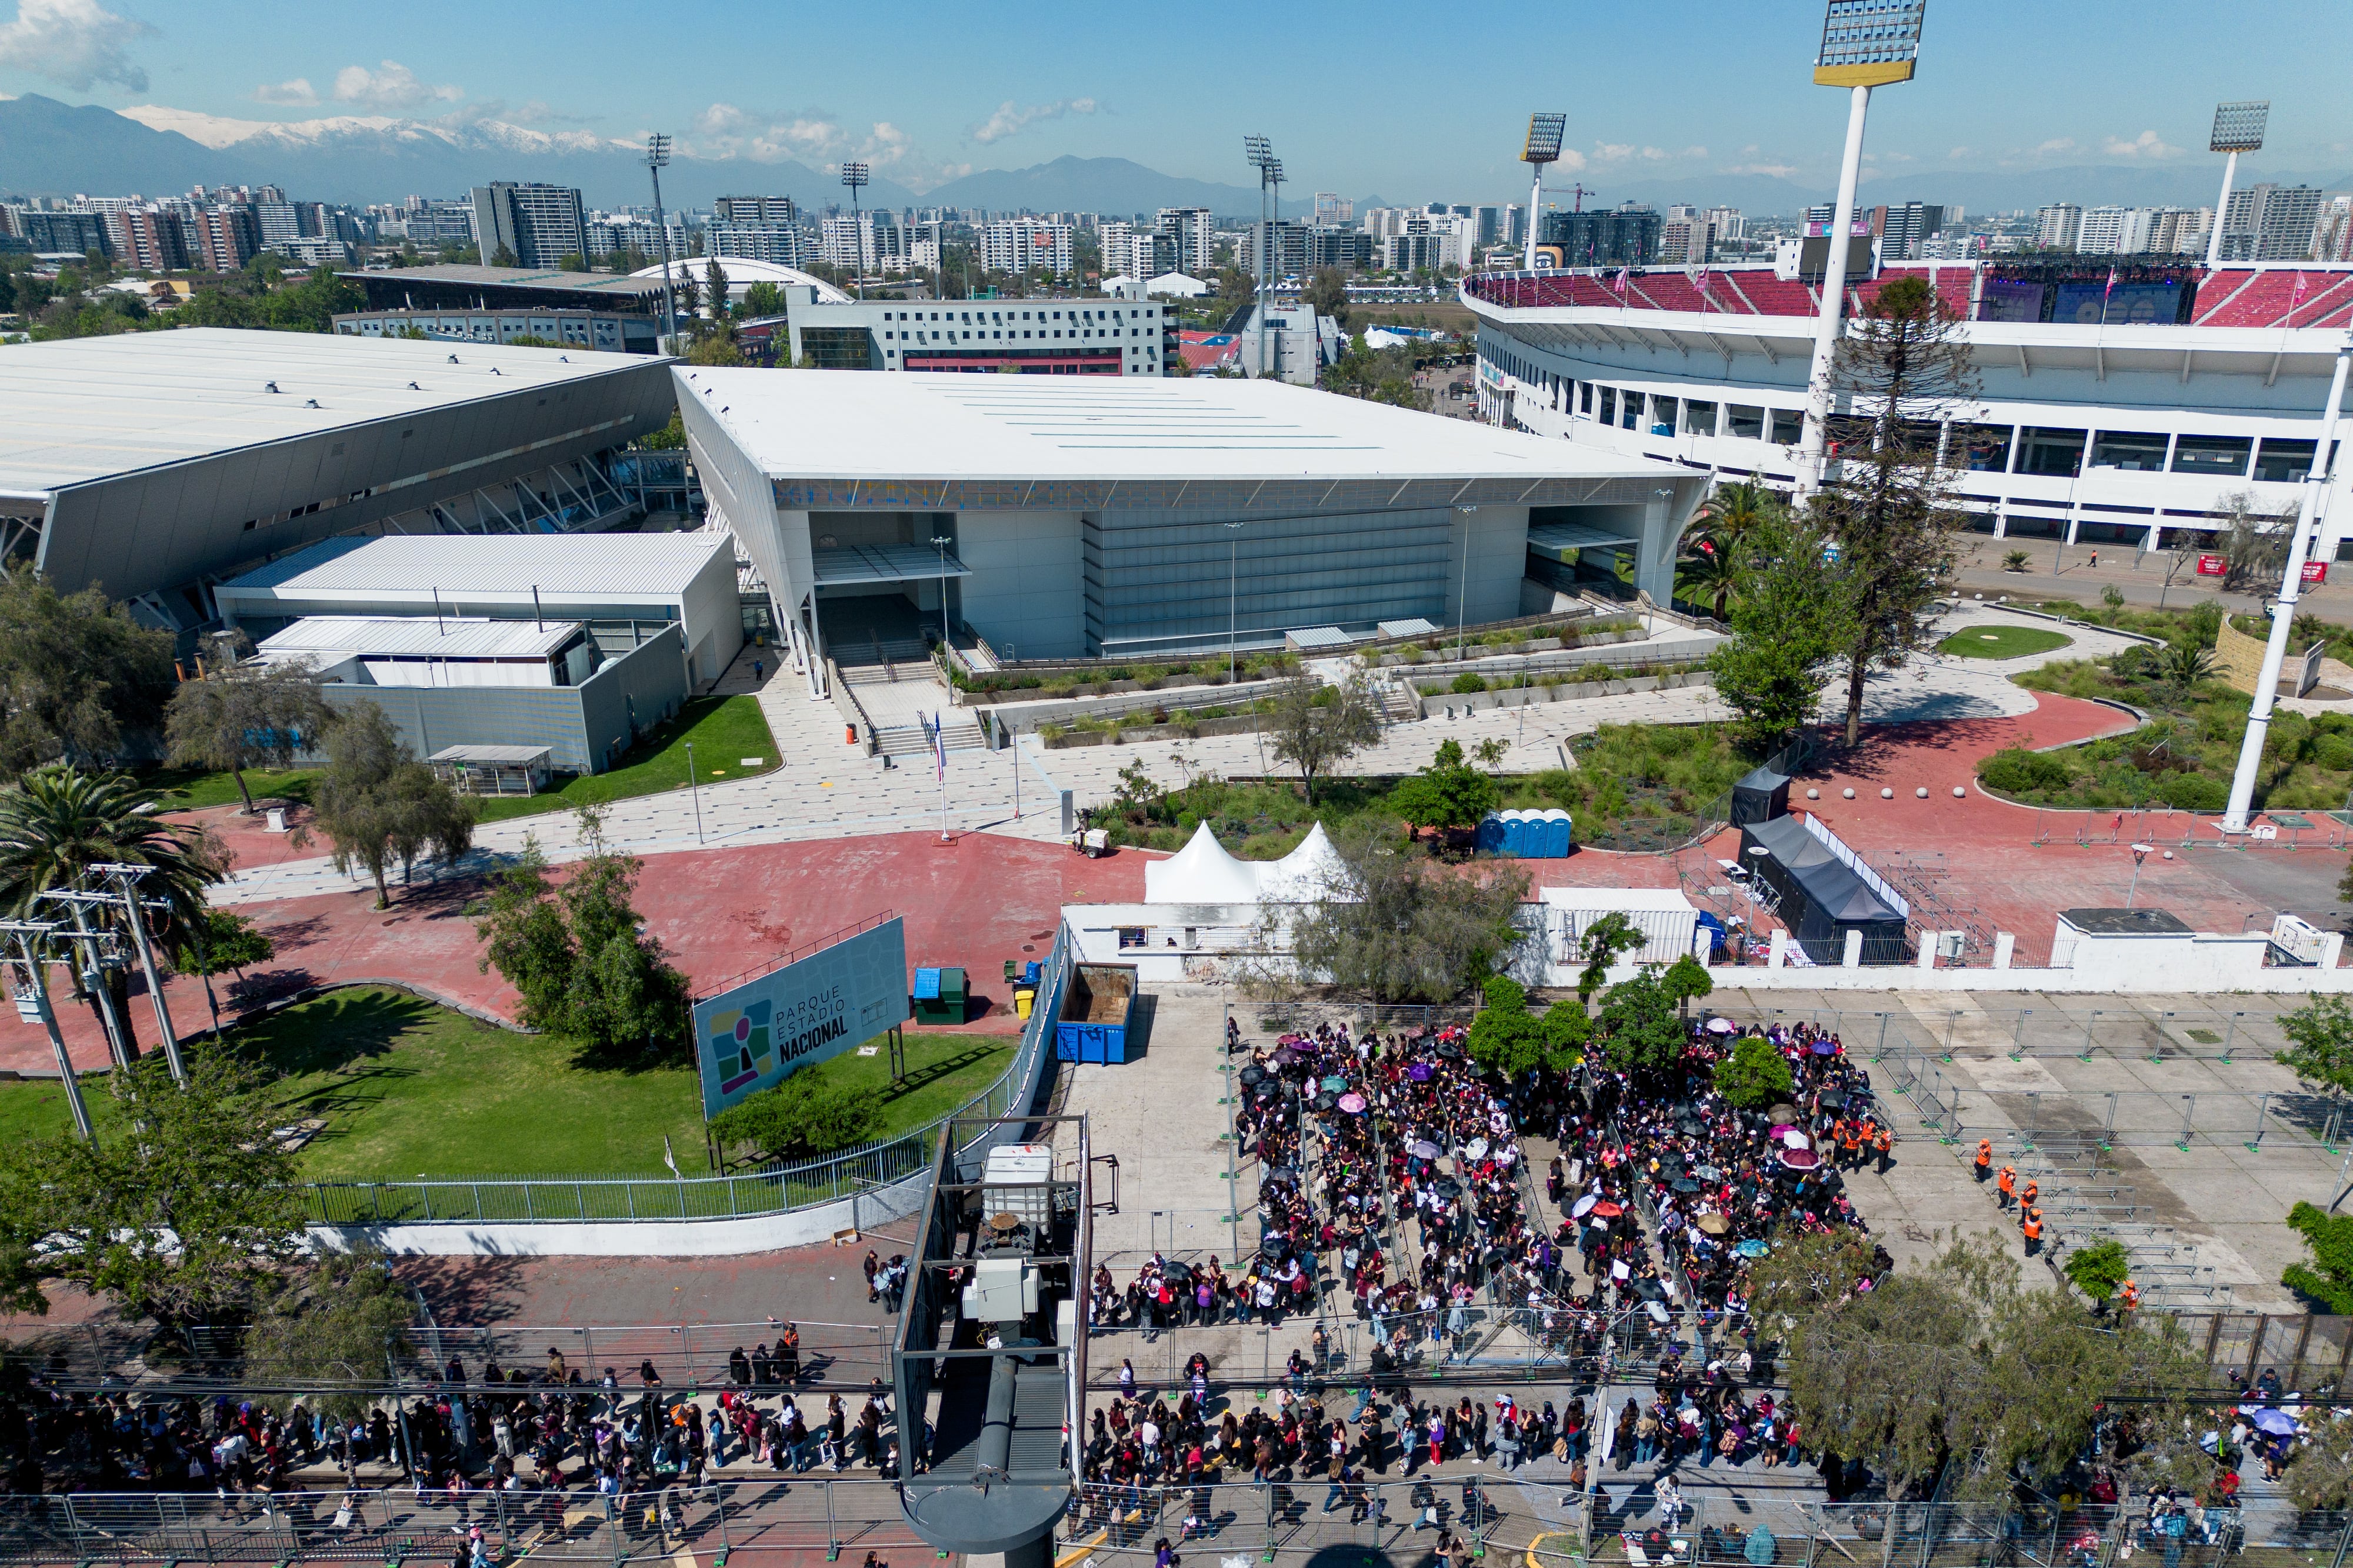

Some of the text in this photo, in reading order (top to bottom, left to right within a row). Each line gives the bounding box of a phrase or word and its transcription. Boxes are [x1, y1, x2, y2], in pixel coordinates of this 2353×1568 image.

[776, 985, 839, 1025] PARQUE
[778, 999, 844, 1039] ESTADIO
[779, 1016, 848, 1065] NACIONAL
